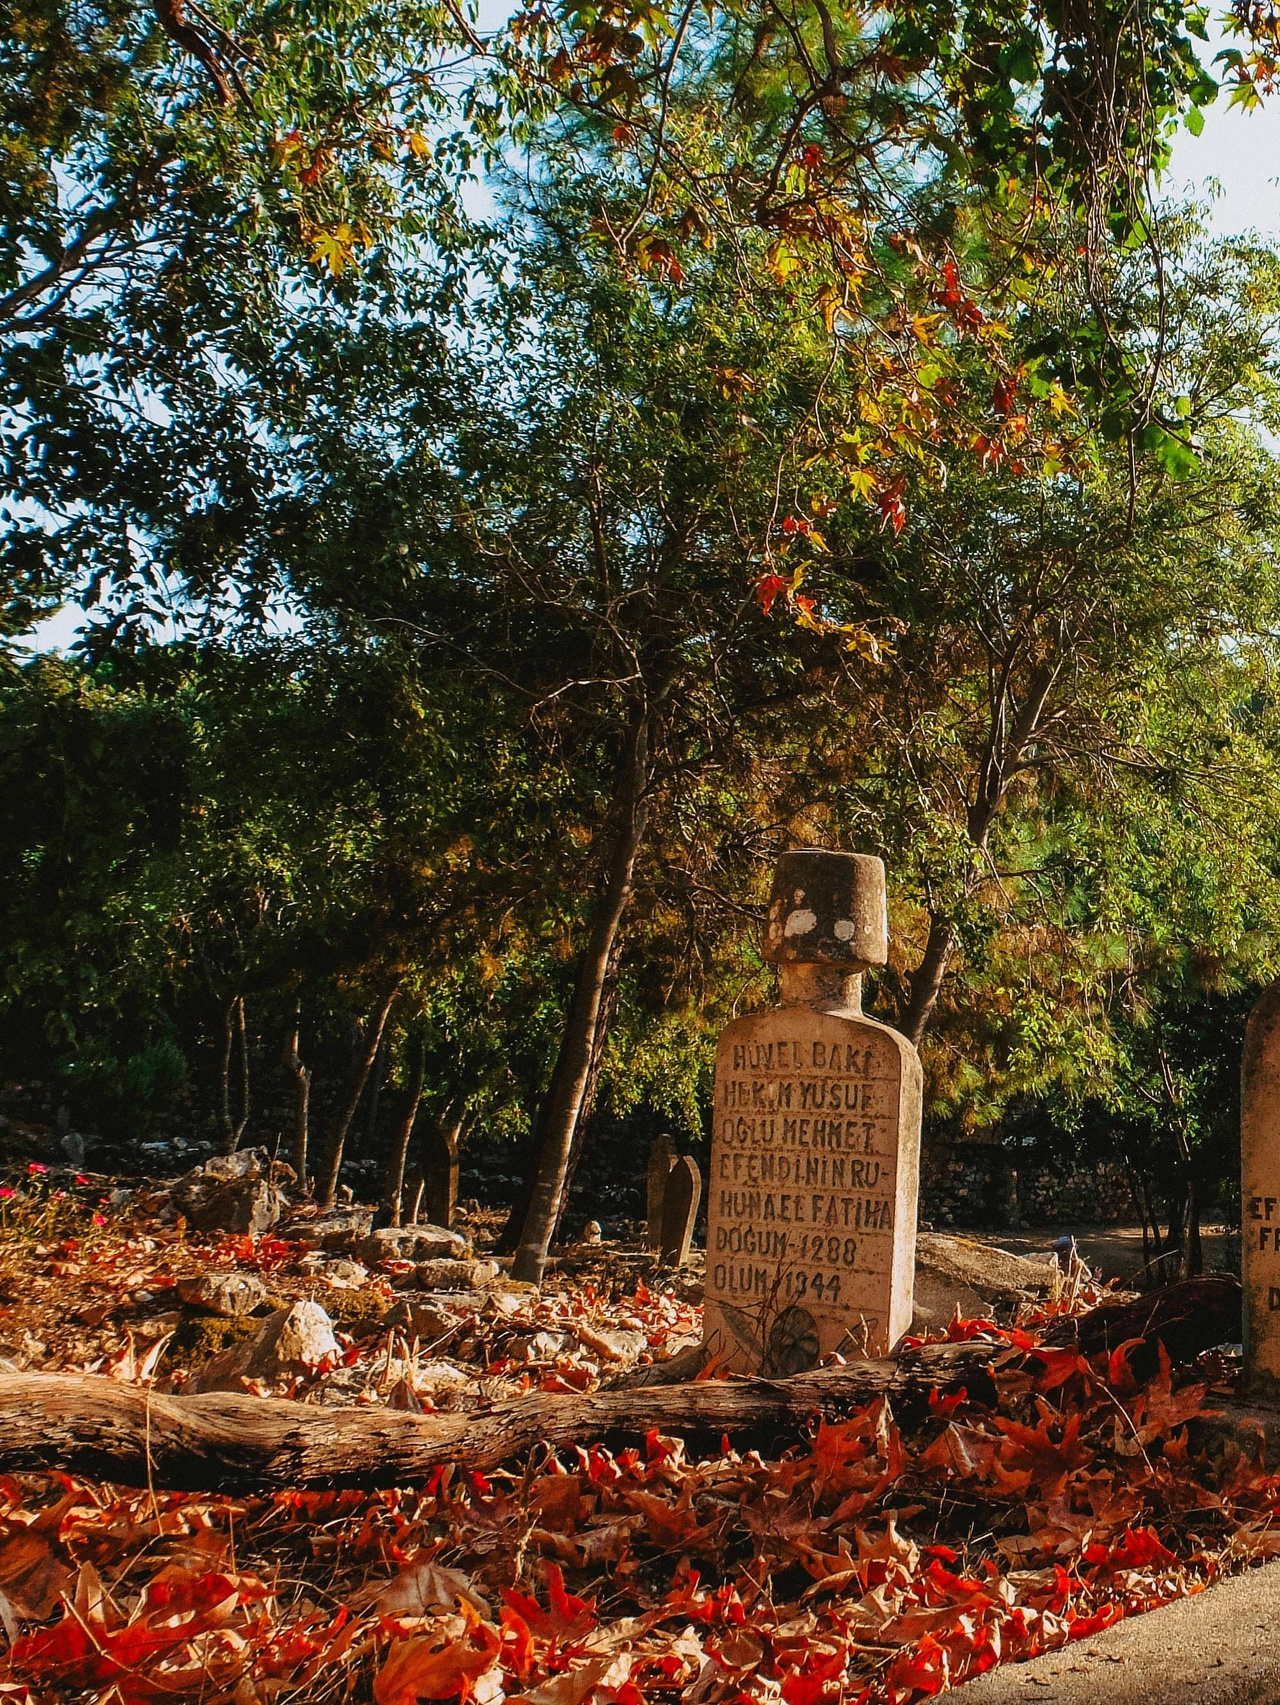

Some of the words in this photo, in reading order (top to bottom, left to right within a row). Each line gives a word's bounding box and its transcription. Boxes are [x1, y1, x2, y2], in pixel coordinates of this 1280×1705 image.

[800, 1081, 874, 1111] YUSUF
[782, 1117, 876, 1152] MEHMET
[719, 1153, 845, 1187] EFENDİNİN
[811, 1194, 892, 1230] FATİHA
